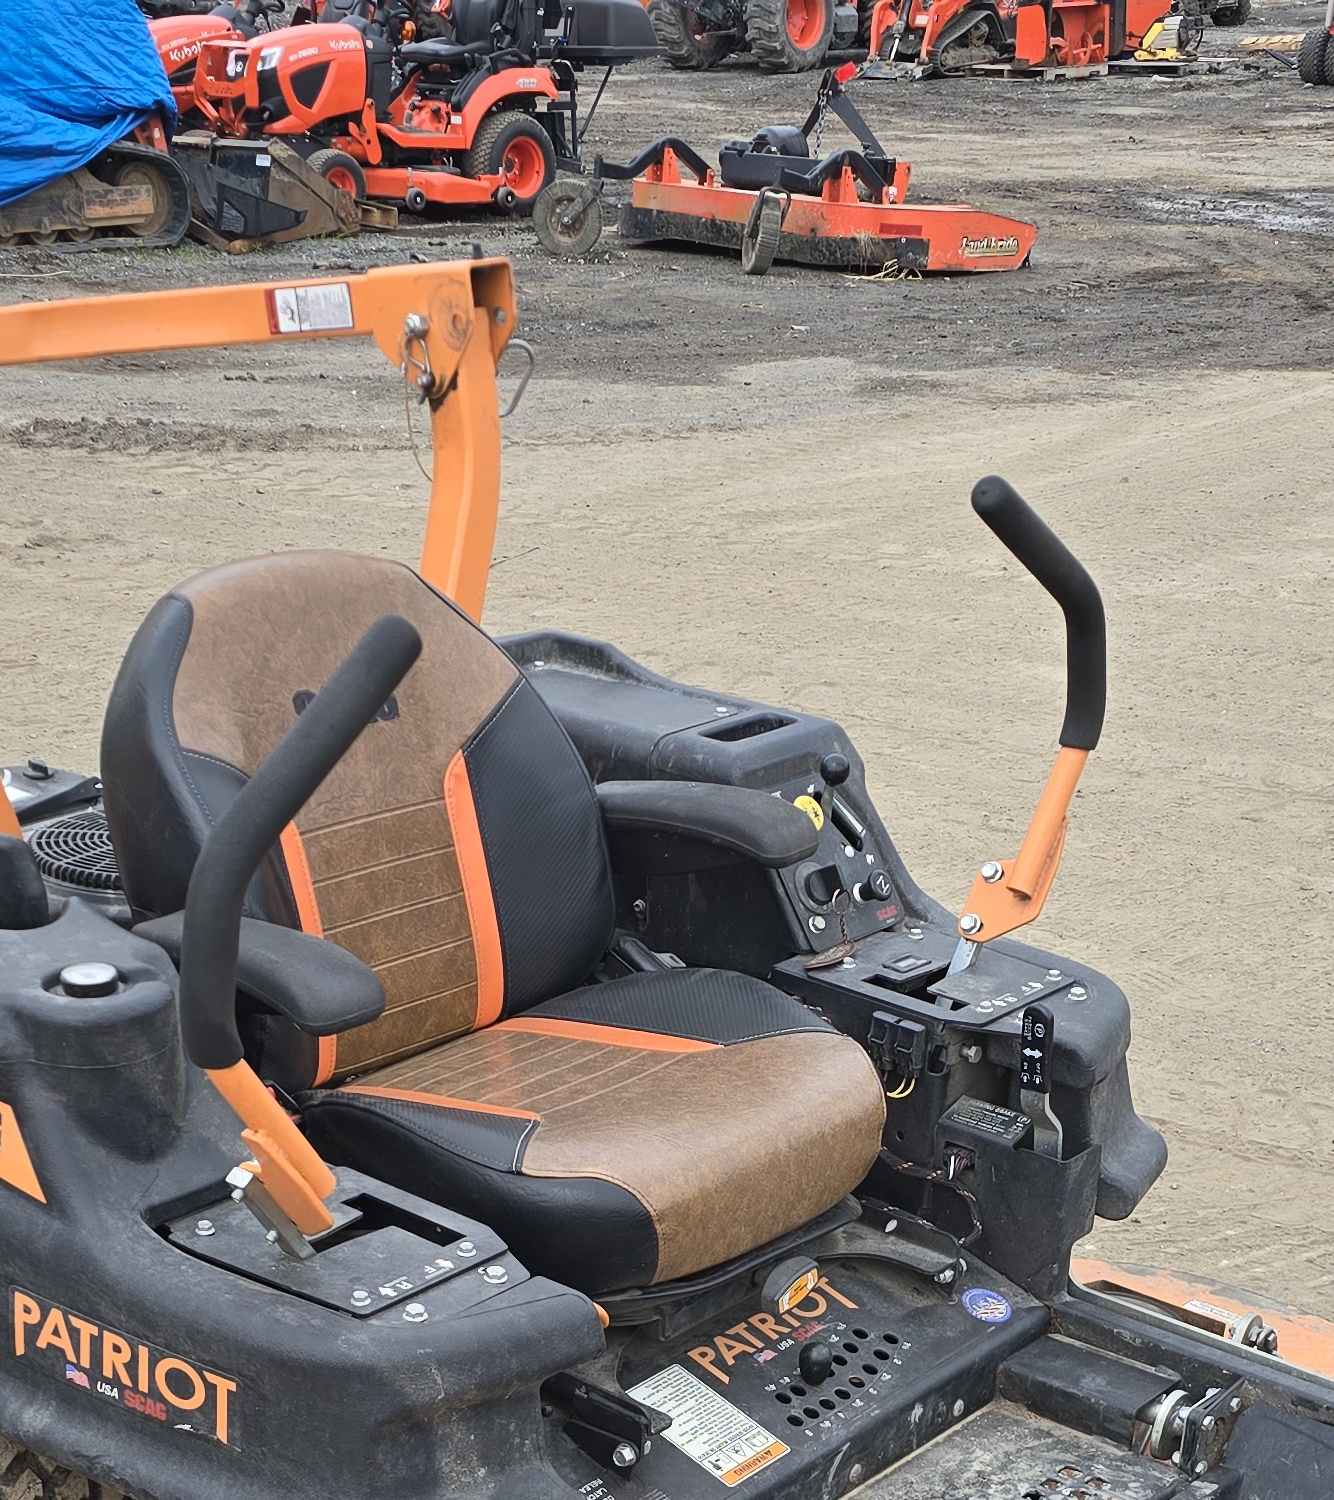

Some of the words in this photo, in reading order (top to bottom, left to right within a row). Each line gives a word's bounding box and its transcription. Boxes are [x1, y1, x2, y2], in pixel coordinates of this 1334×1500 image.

[686, 1276, 860, 1385] PATRIOT
[776, 1337, 795, 1351] USA
[791, 1320, 825, 1342] SCAG
[14, 1290, 237, 1445] PATRIOT
[96, 1380, 119, 1400] USA
[124, 1389, 167, 1421] SCAG
[731, 1450, 769, 1478] WARNING
[578, 1477, 603, 1494] RELEA
